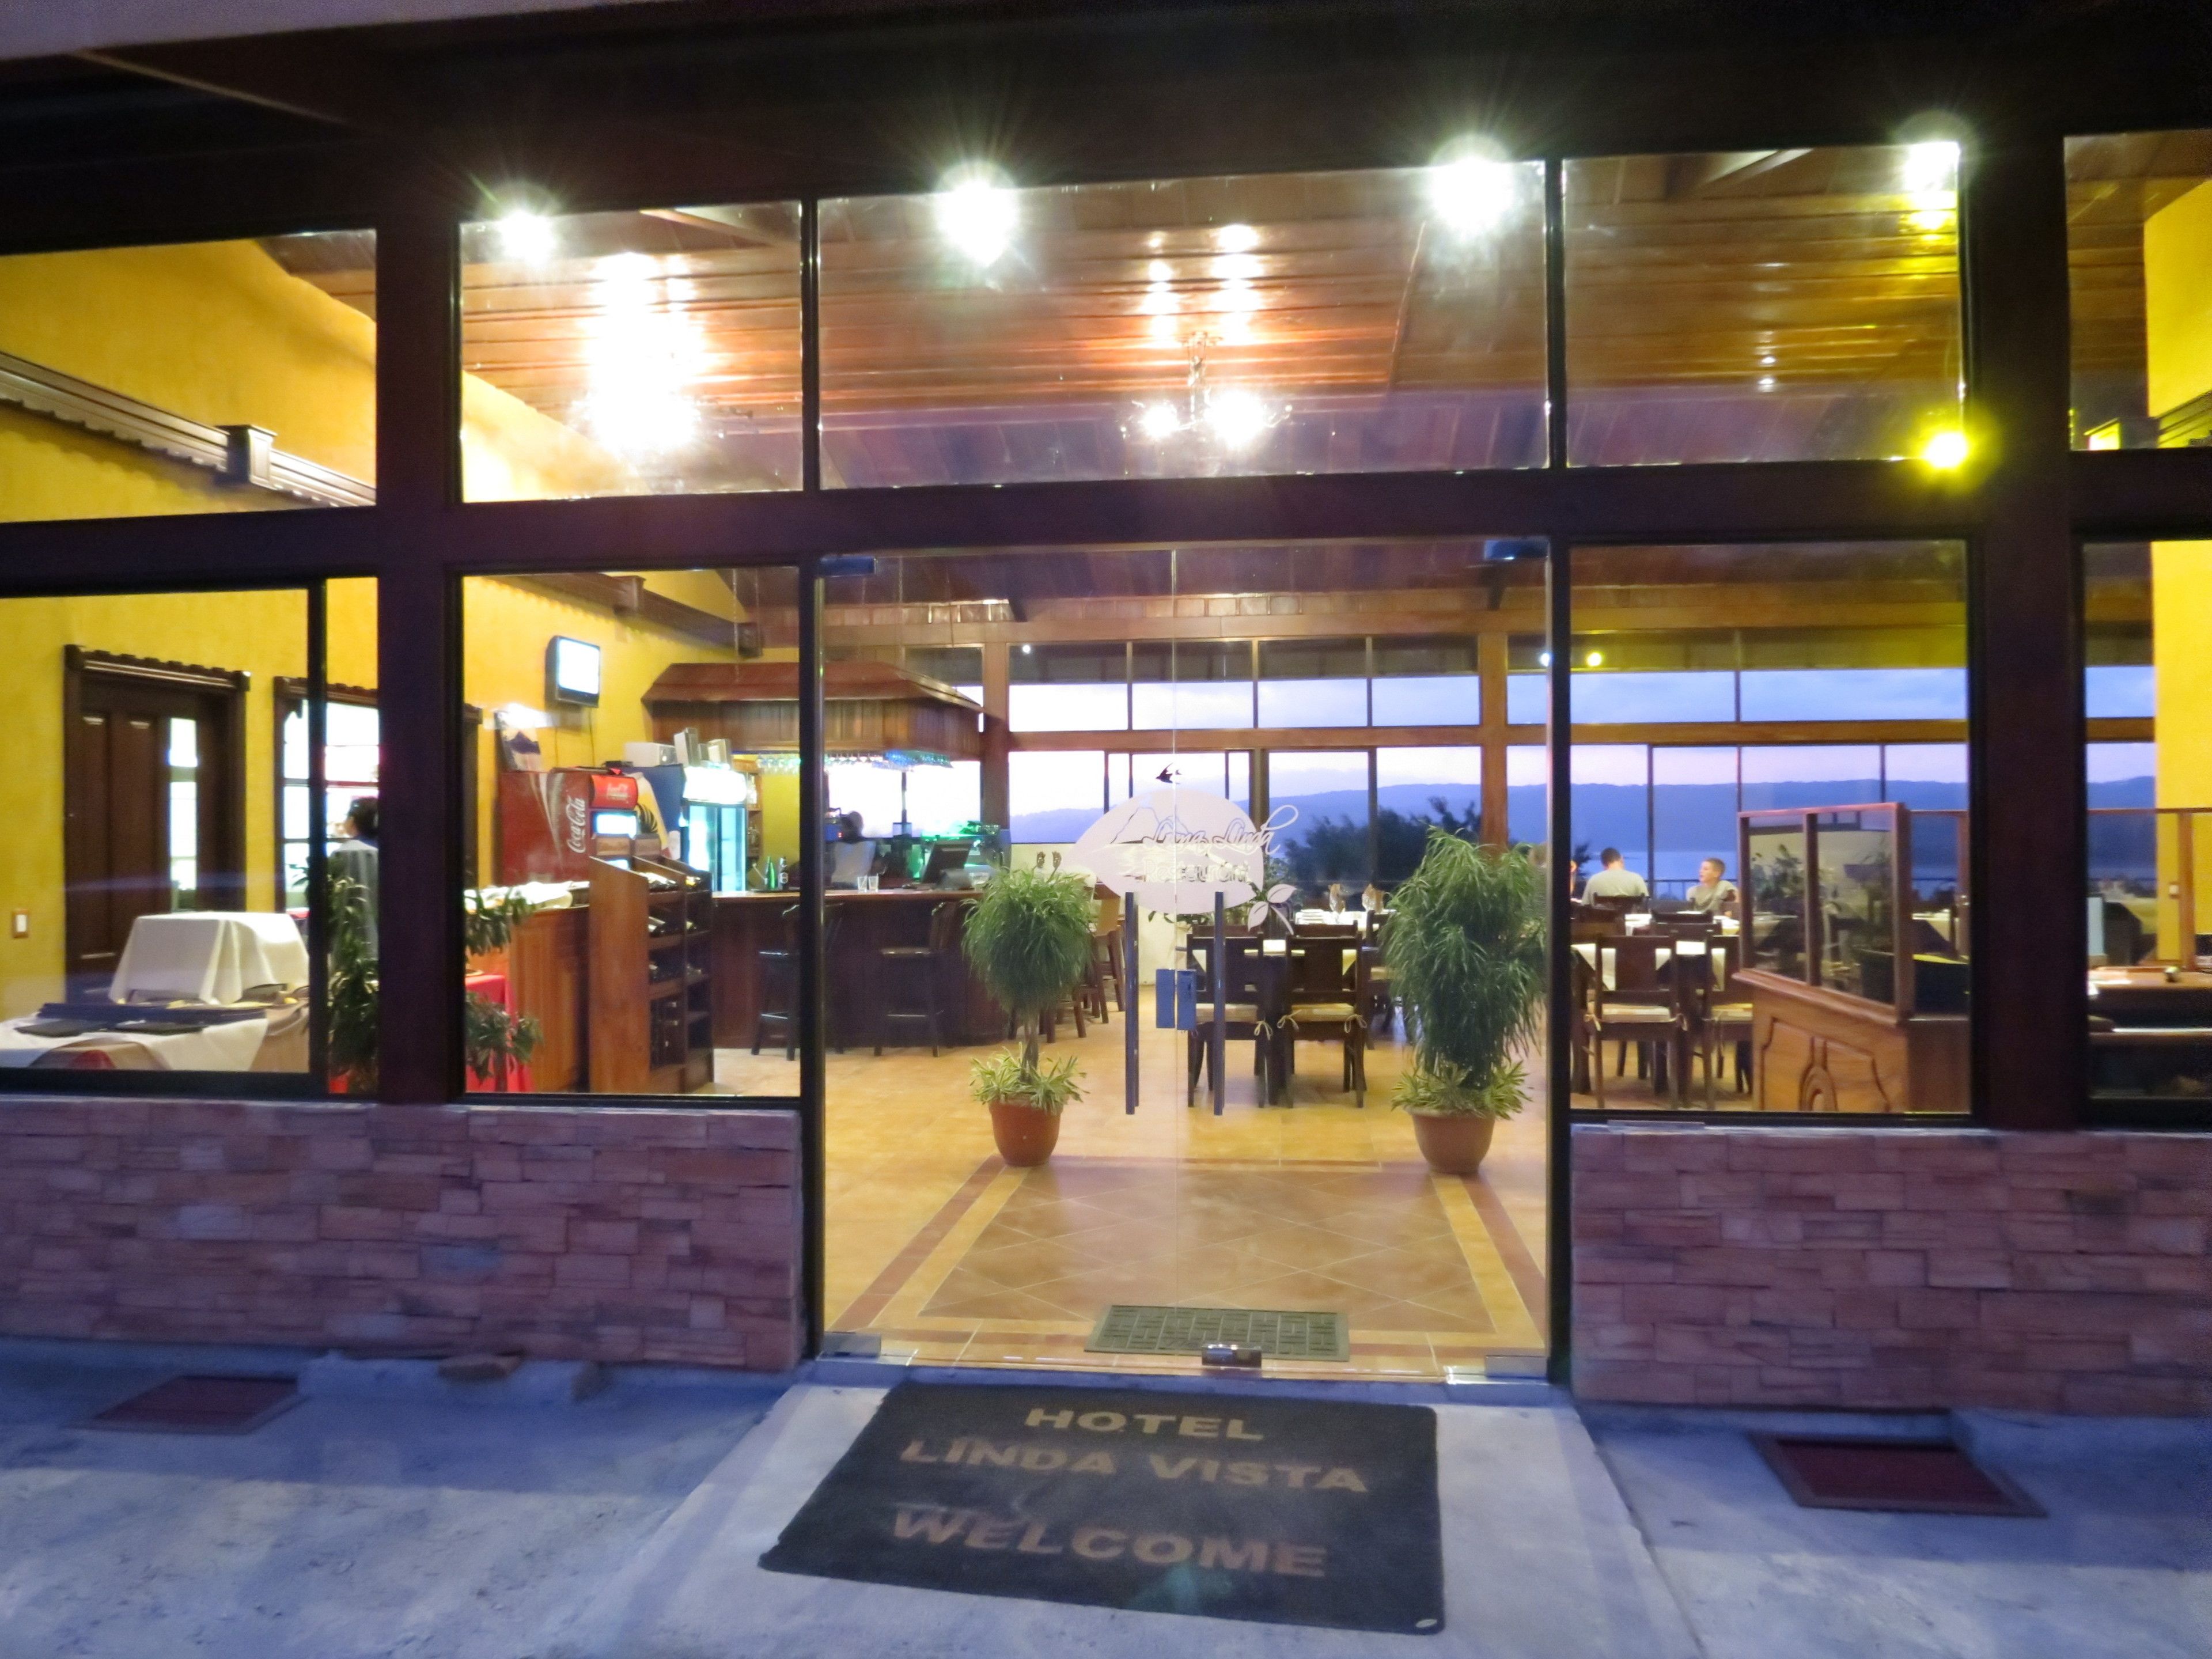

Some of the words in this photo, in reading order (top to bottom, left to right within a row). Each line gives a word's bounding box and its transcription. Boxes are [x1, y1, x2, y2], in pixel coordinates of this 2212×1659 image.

[1211, 805, 1300, 856] Linda
[1025, 1407, 1265, 1441] HOTEL
[900, 1437, 1115, 1475] LINDA
[1150, 1452, 1369, 1493] VISTA
[891, 1506, 1328, 1577] WELCOME
